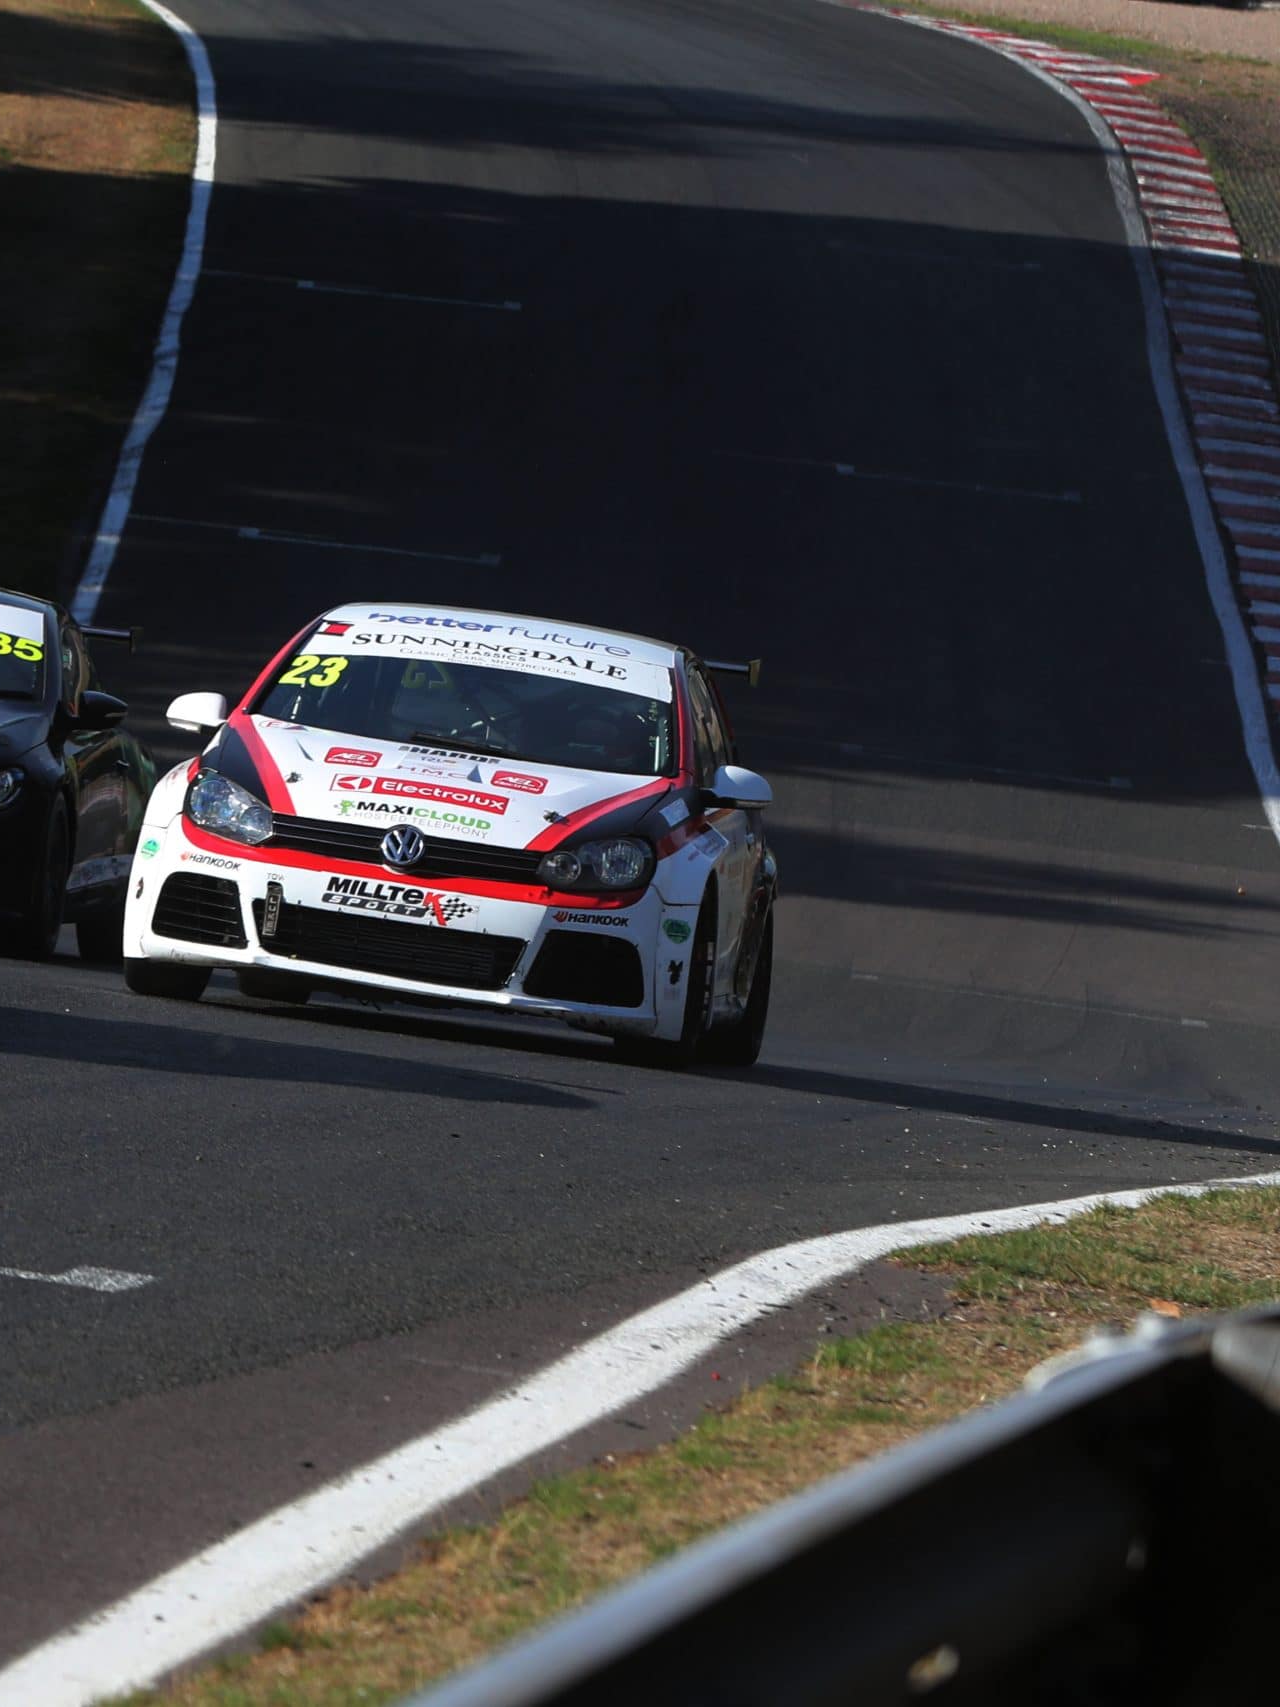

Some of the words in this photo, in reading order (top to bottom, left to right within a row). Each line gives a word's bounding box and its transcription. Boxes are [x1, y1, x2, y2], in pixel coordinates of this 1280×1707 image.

[368, 612, 503, 633] better
[508, 626, 631, 657] future
[352, 633, 628, 680] SUNNINGDALE
[453, 647, 527, 662] CLASSICS
[278, 654, 349, 687] 23
[381, 780, 505, 811] Electrolux
[353, 811, 407, 823] HOSTED
[412, 816, 489, 839] TELEPHONY
[356, 800, 492, 830] MAXICLOUD
[328, 895, 417, 915] SPORT
